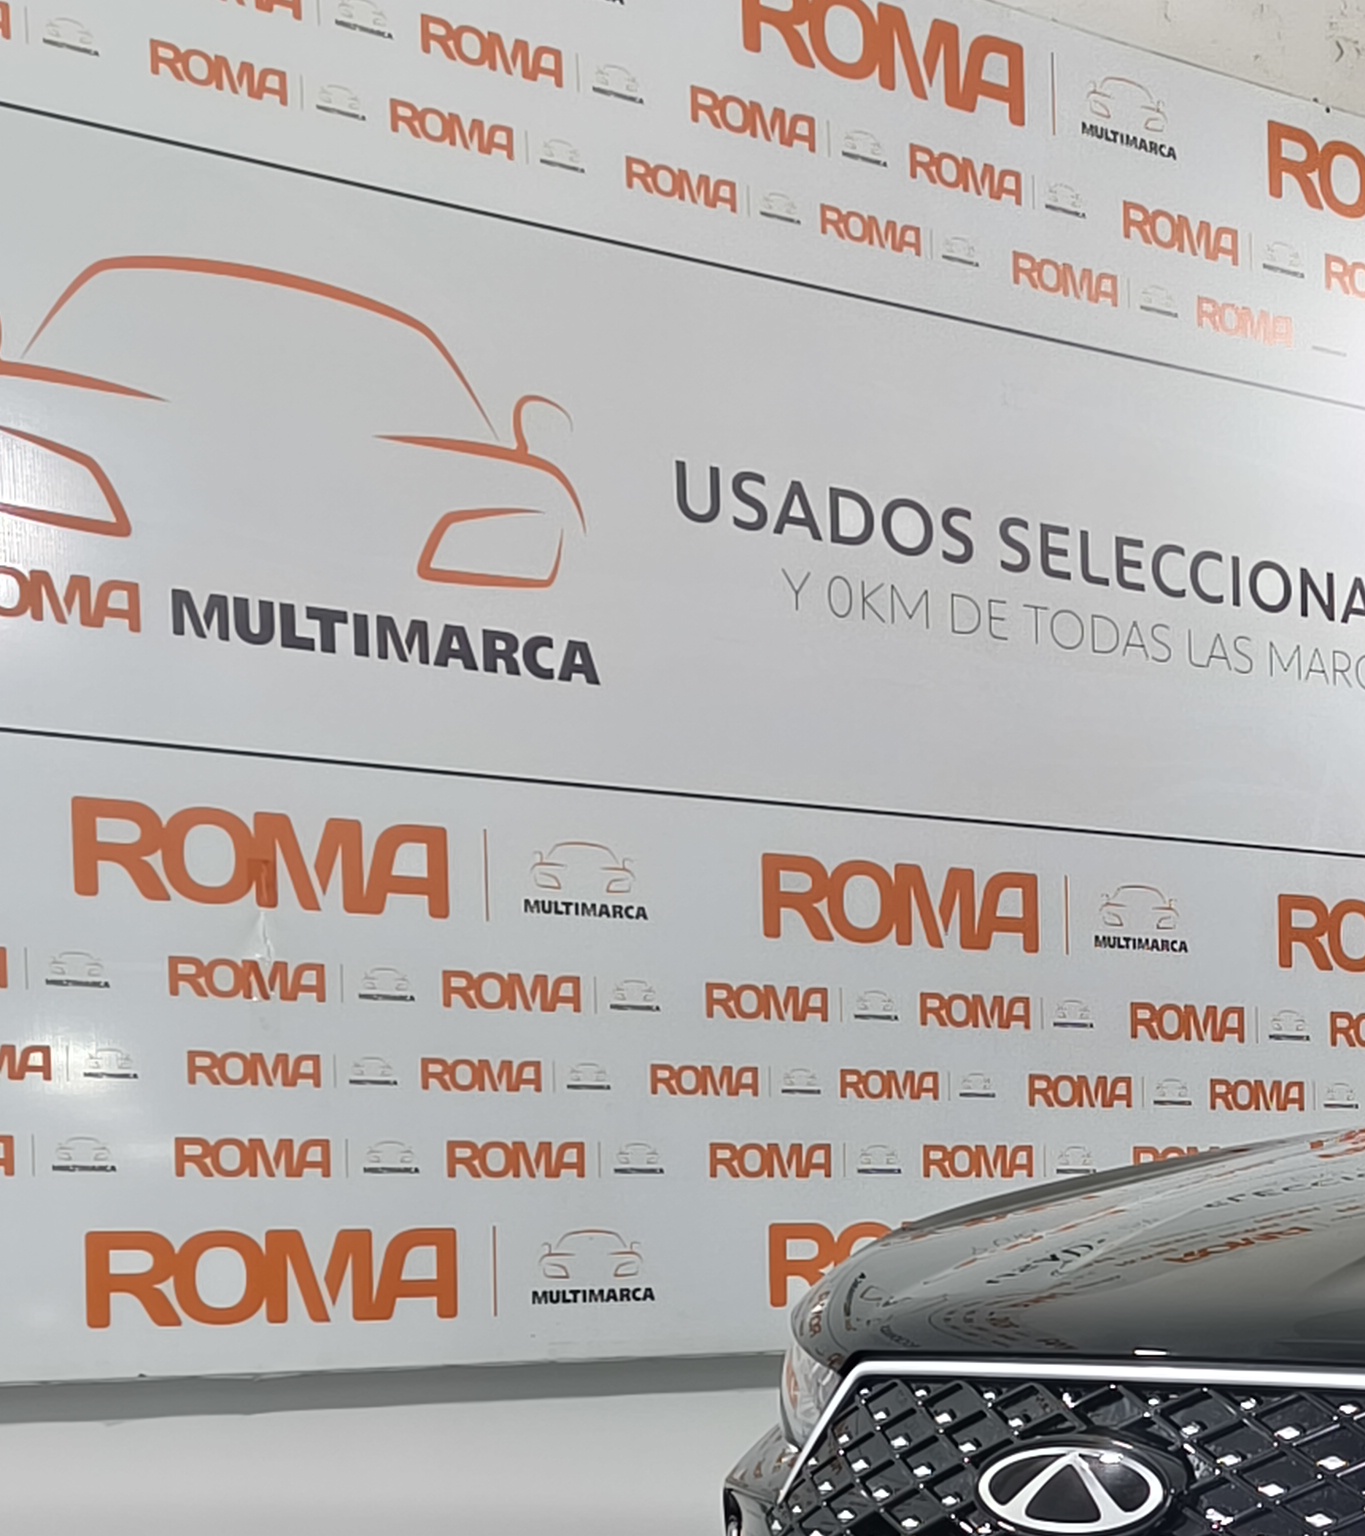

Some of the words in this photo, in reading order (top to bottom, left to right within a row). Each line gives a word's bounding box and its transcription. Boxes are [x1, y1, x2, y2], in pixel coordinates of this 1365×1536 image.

[420, 14, 564, 88] ROMA
[741, 0, 1025, 128] ROMA
[150, 39, 288, 107] ROMA
[390, 98, 514, 161] ROMA
[690, 85, 816, 153] ROMA
[1081, 122, 1177, 160] MULTIMARCA
[625, 156, 737, 214] ROMA
[909, 143, 1022, 206] ROMA
[820, 204, 922, 256] ROMA
[1122, 200, 1239, 267] ROMA
[1012, 250, 1119, 307] ROMA
[675, 460, 974, 564] USADOS
[171, 589, 601, 686] MULTIMARCA
[781, 568, 811, 612] Y
[951, 593, 1008, 641] DE
[1023, 604, 1172, 663] TODAS
[1187, 632, 1254, 676] LAS
[71, 796, 450, 920] ROMA
[524, 898, 649, 921] MULTIMARCA
[761, 853, 1040, 955] ROMA
[1094, 934, 1189, 954] MULTIMARCA
[169, 956, 326, 1004] ROMA
[442, 970, 582, 1013] ROMA
[706, 982, 828, 1023] ROMA
[920, 992, 1031, 1031] ROMA
[1130, 1002, 1245, 1045] ROMA
[187, 1050, 322, 1089] ROMA
[421, 1058, 542, 1093] ROMA
[650, 1064, 759, 1098] ROMA
[840, 1069, 939, 1102] ROMA
[1028, 1074, 1133, 1110] ROMA
[1210, 1078, 1304, 1113] ROMA
[175, 1137, 332, 1179] ROMA
[446, 1140, 586, 1180] ROMA
[710, 1143, 832, 1180] ROMA
[923, 1144, 1034, 1180] ROMA
[85, 1227, 459, 1331] ROMA
[531, 1286, 656, 1305] MULTIMARCA
